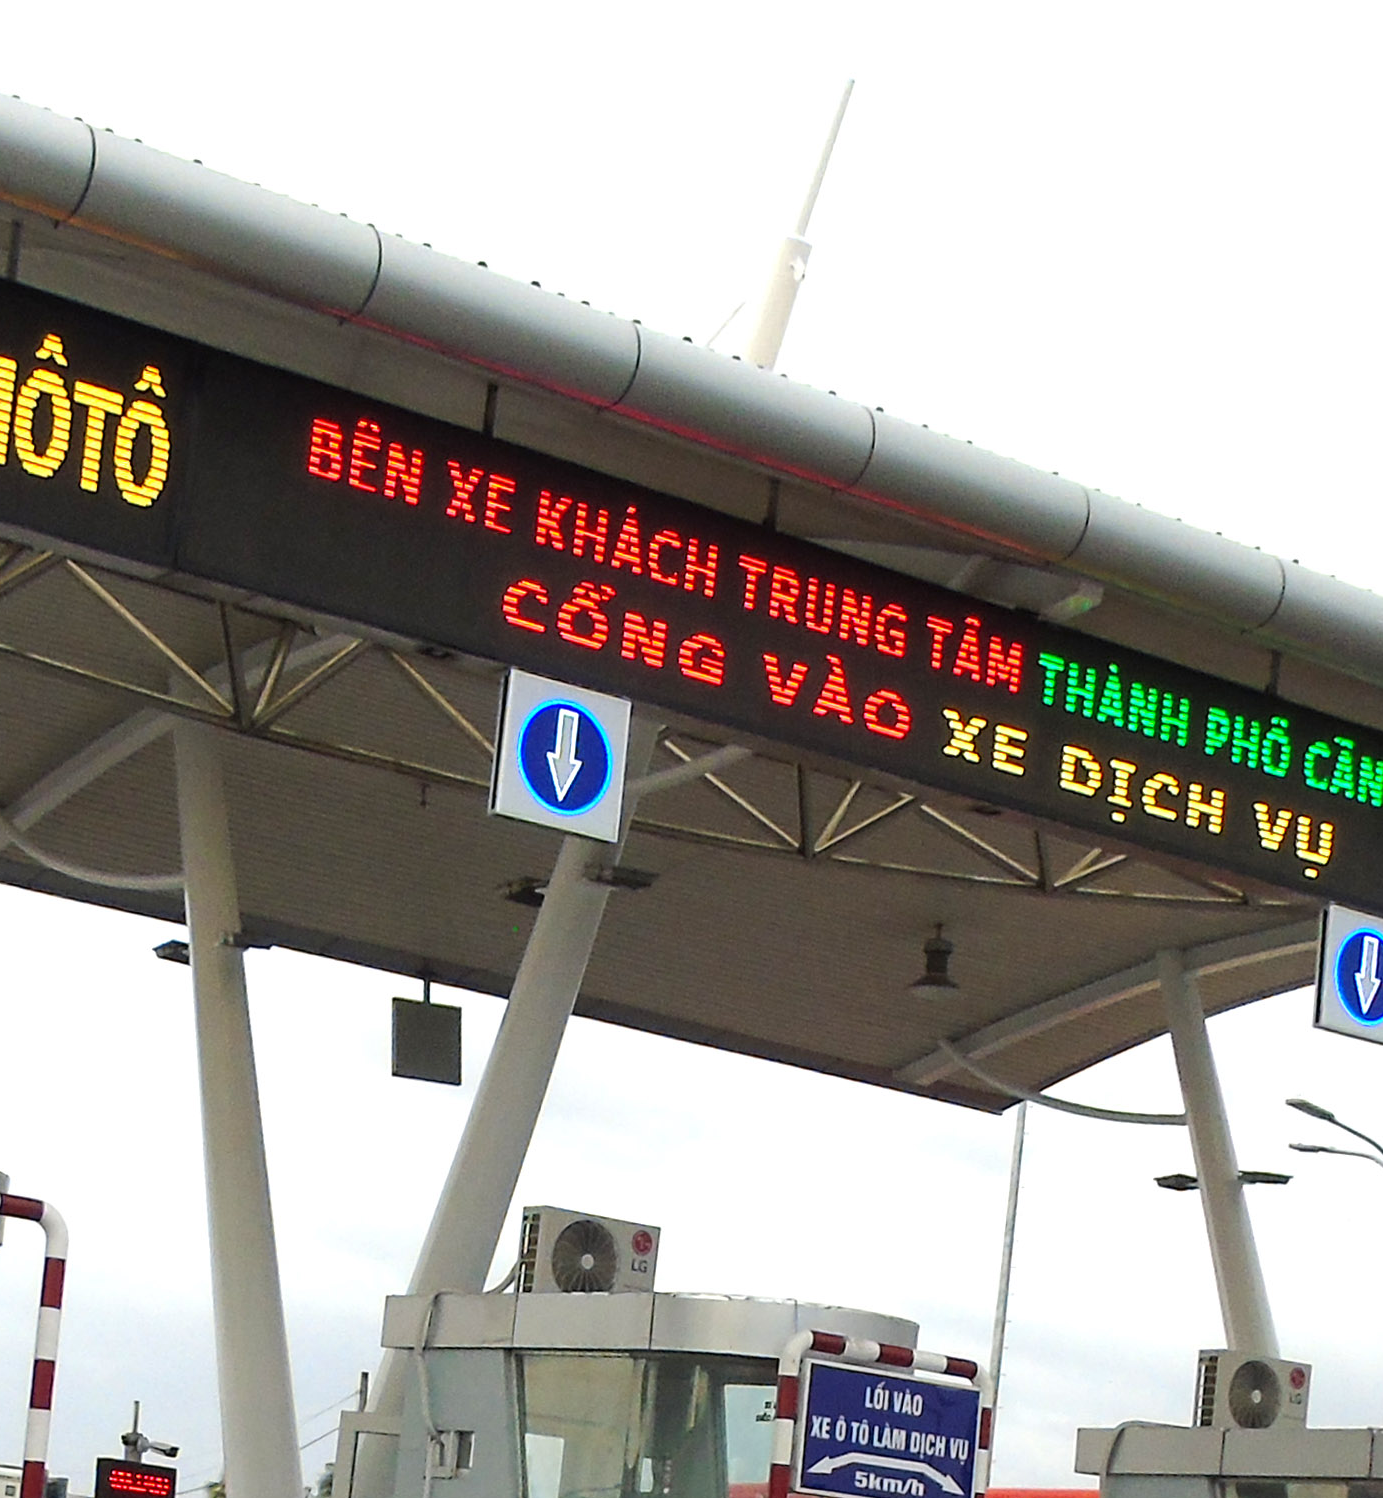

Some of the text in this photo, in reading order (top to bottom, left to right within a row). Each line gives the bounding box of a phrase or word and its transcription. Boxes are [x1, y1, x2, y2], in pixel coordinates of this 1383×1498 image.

[445, 458, 516, 534] XE
[535, 490, 719, 598] KHÁCH
[738, 552, 908, 658] TRUNG
[925, 615, 1024, 695] TÂM
[1037, 651, 1191, 748] THÀNH
[762, 653, 913, 741] VÀO
[941, 708, 1028, 776] XE
[1058, 744, 1226, 834] DỊCH
[1252, 802, 1335, 879] VỤ
[631, 1259, 648, 1274] LG
[865, 1382, 924, 1417] LỐI VÀO
[810, 1415, 831, 1439] XE
[873, 1422, 906, 1450] LÀM
[910, 1431, 948, 1459] DỊCH
[950, 1437, 970, 1465] VỤ
[854, 1470, 926, 1497] 5km/h
